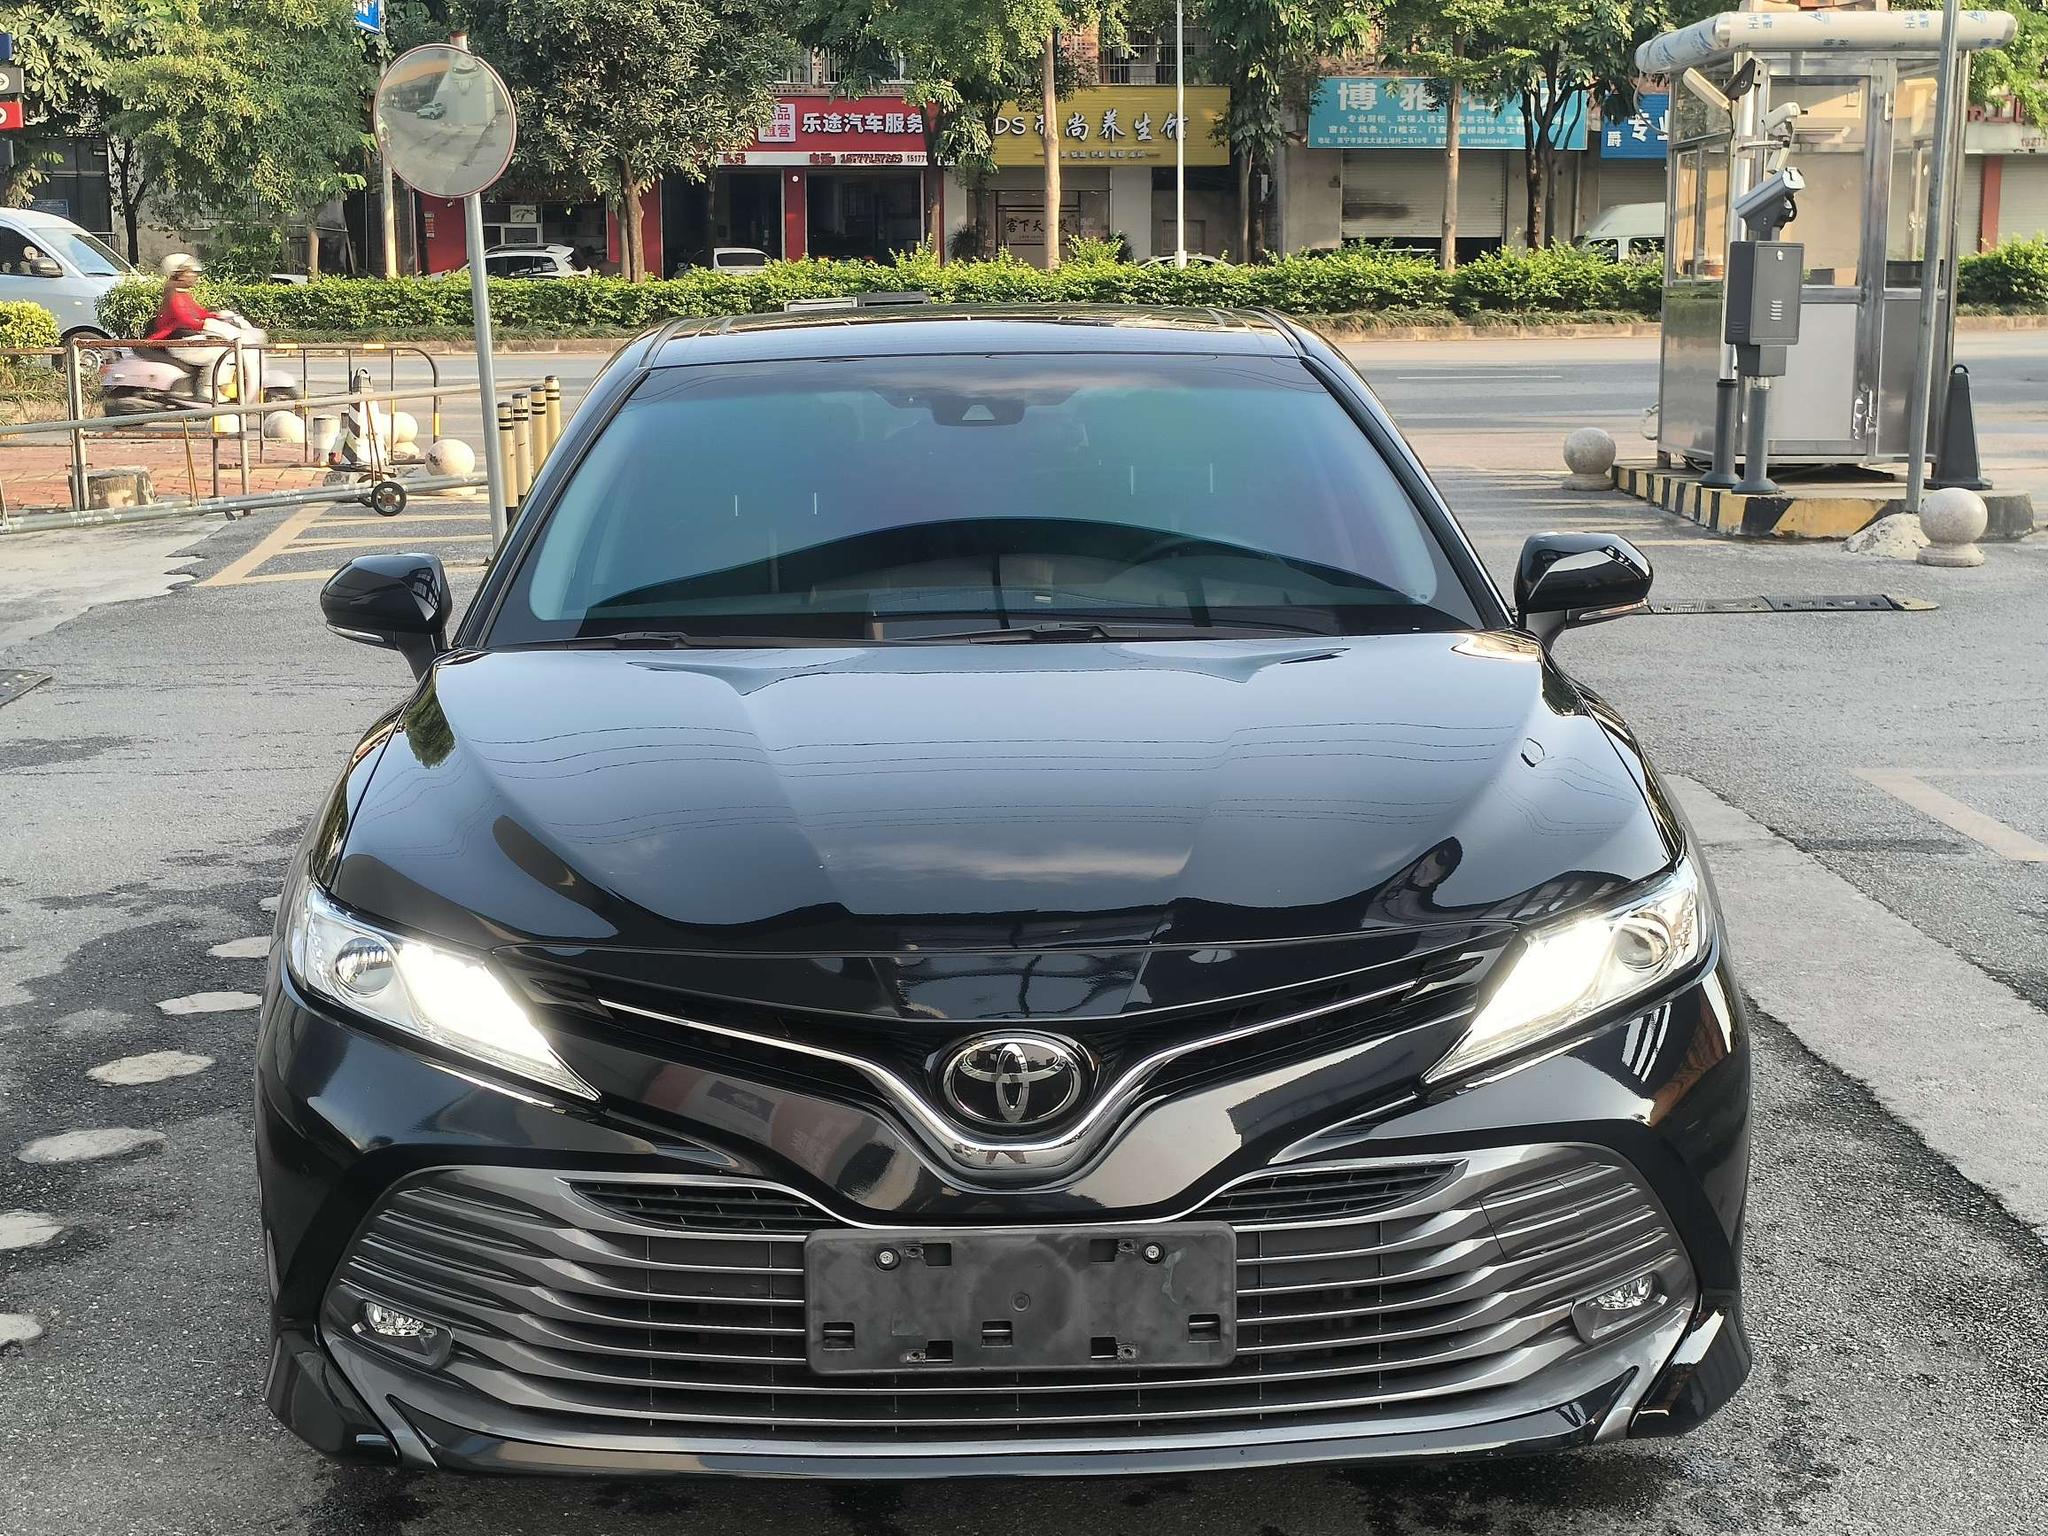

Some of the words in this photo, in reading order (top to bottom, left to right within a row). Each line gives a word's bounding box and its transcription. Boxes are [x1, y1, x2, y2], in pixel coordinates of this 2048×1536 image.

[801, 112, 923, 135] 乐途汽车服务
[994, 116, 1027, 136] DS
